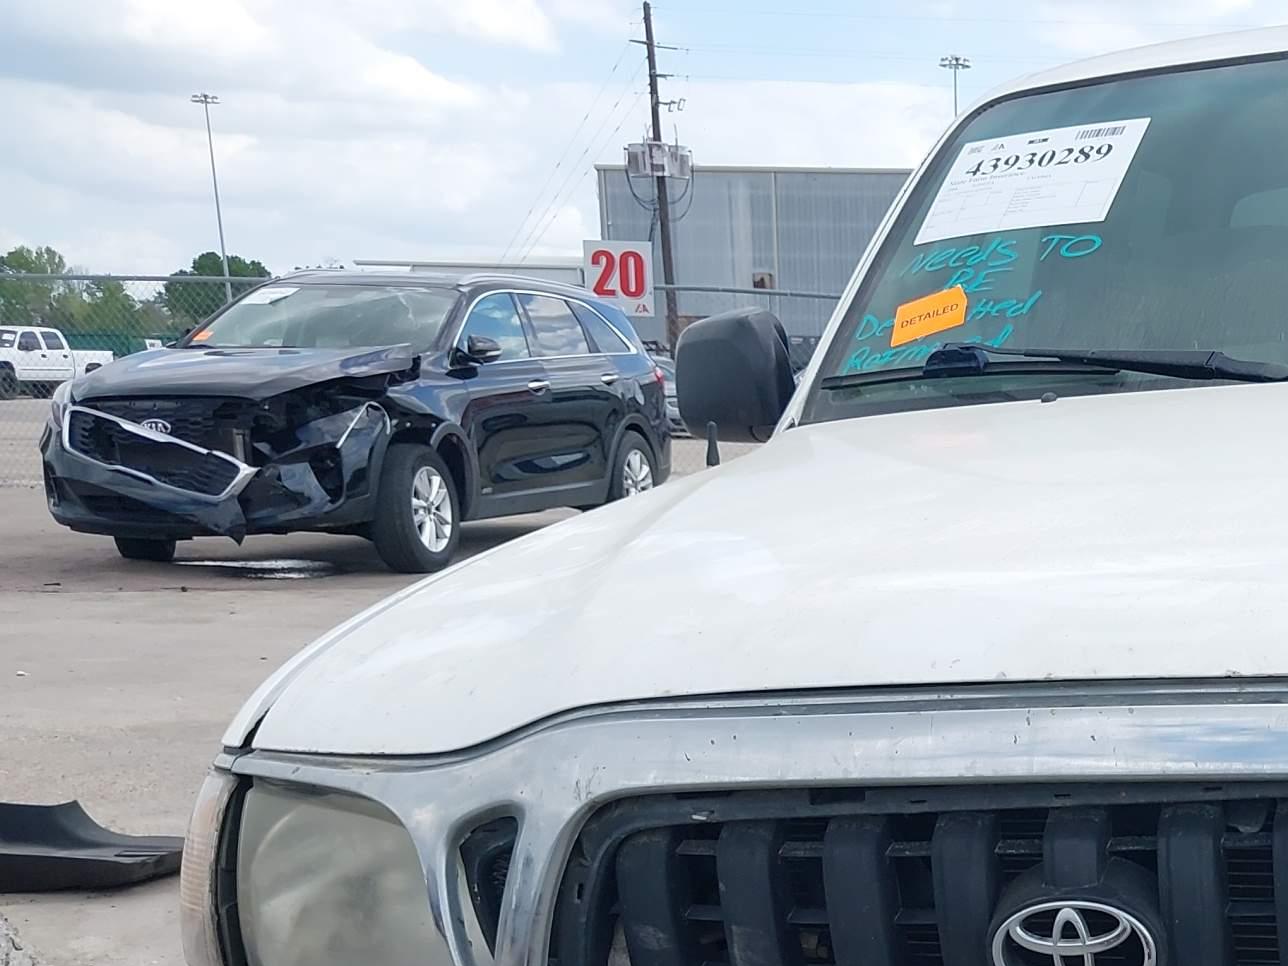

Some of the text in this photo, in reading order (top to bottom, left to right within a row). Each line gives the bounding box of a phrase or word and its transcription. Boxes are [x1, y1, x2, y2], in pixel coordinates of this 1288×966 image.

[965, 143, 1114, 177] 43930289
[1039, 234, 1103, 261] TO
[591, 249, 645, 298] 20
[900, 303, 959, 329] DETAILED
[144, 422, 166, 433] KIA
